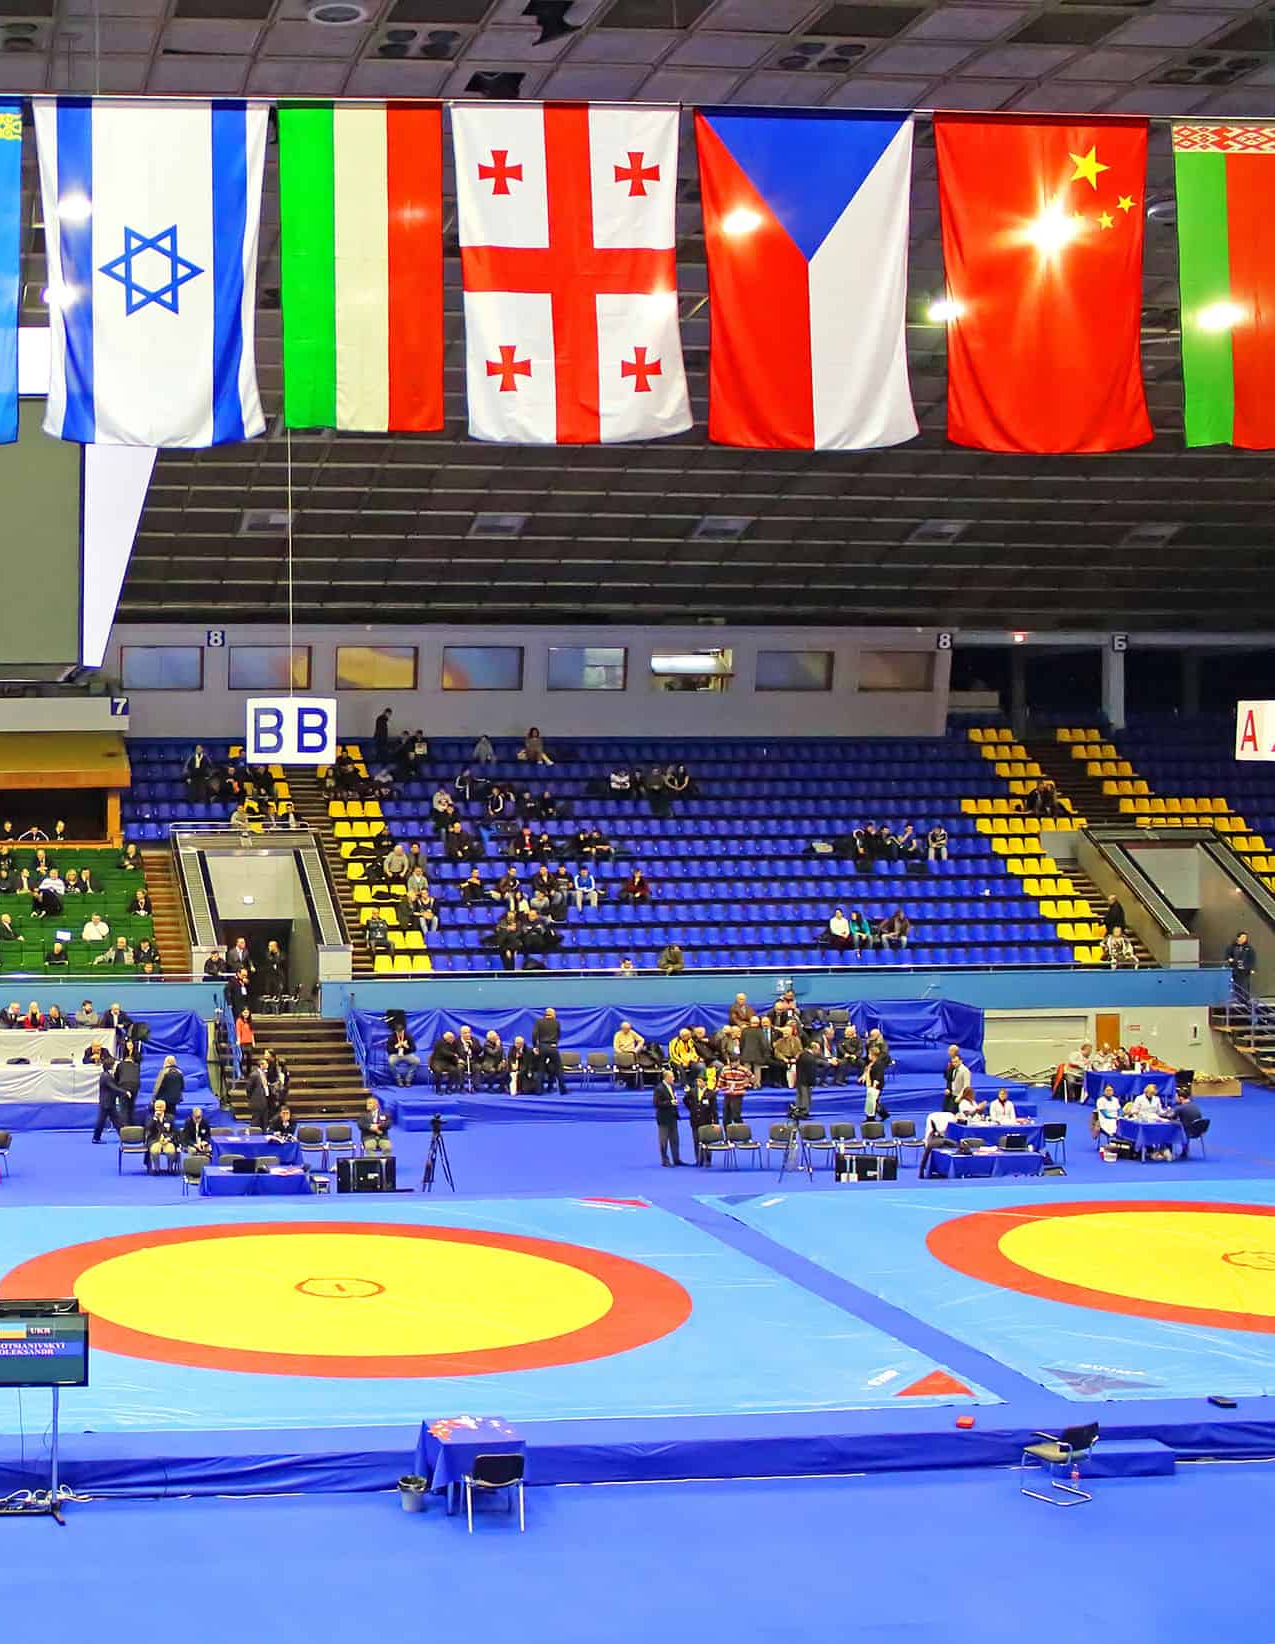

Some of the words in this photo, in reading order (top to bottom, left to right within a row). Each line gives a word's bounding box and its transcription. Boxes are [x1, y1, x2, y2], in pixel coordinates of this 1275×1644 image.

[209, 631, 223, 647] 8
[938, 633, 952, 649] 8
[113, 697, 127, 715] 7
[30, 1327, 51, 1335] UKR
